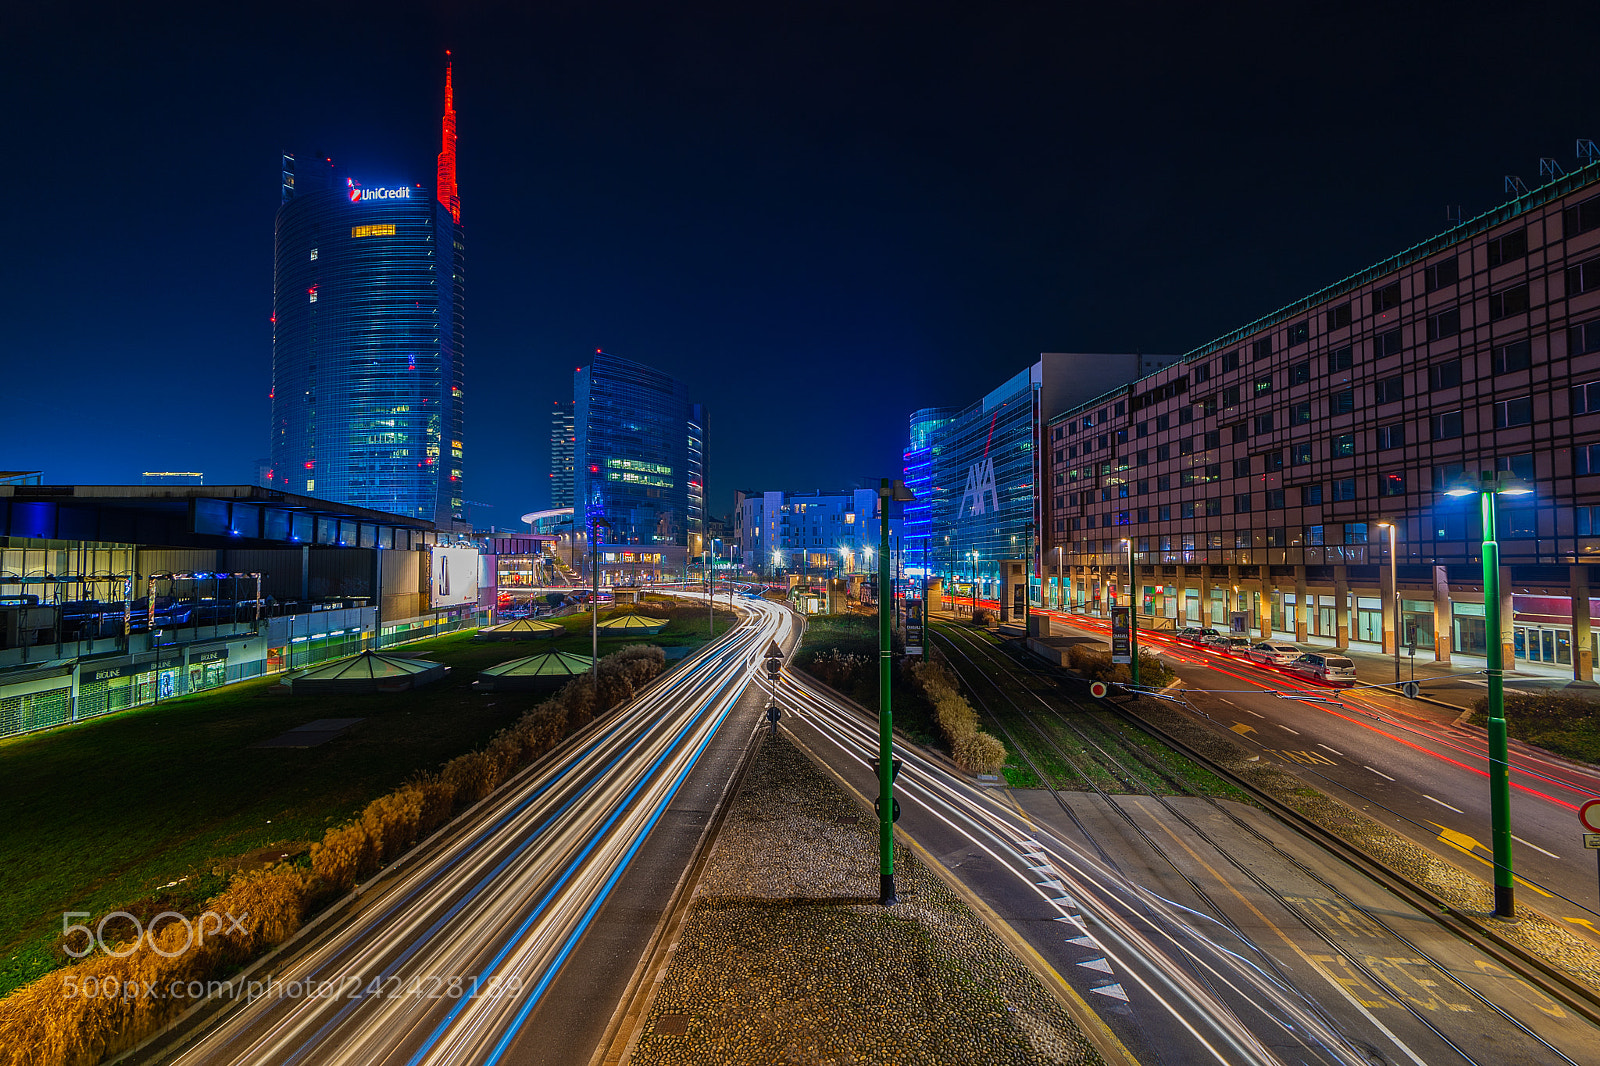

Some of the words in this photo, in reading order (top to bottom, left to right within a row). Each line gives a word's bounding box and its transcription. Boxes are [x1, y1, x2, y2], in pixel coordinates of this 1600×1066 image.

[362, 187, 410, 200] UniCredit
[957, 457, 999, 519] AXA
[1262, 748, 1338, 766] TAXI
